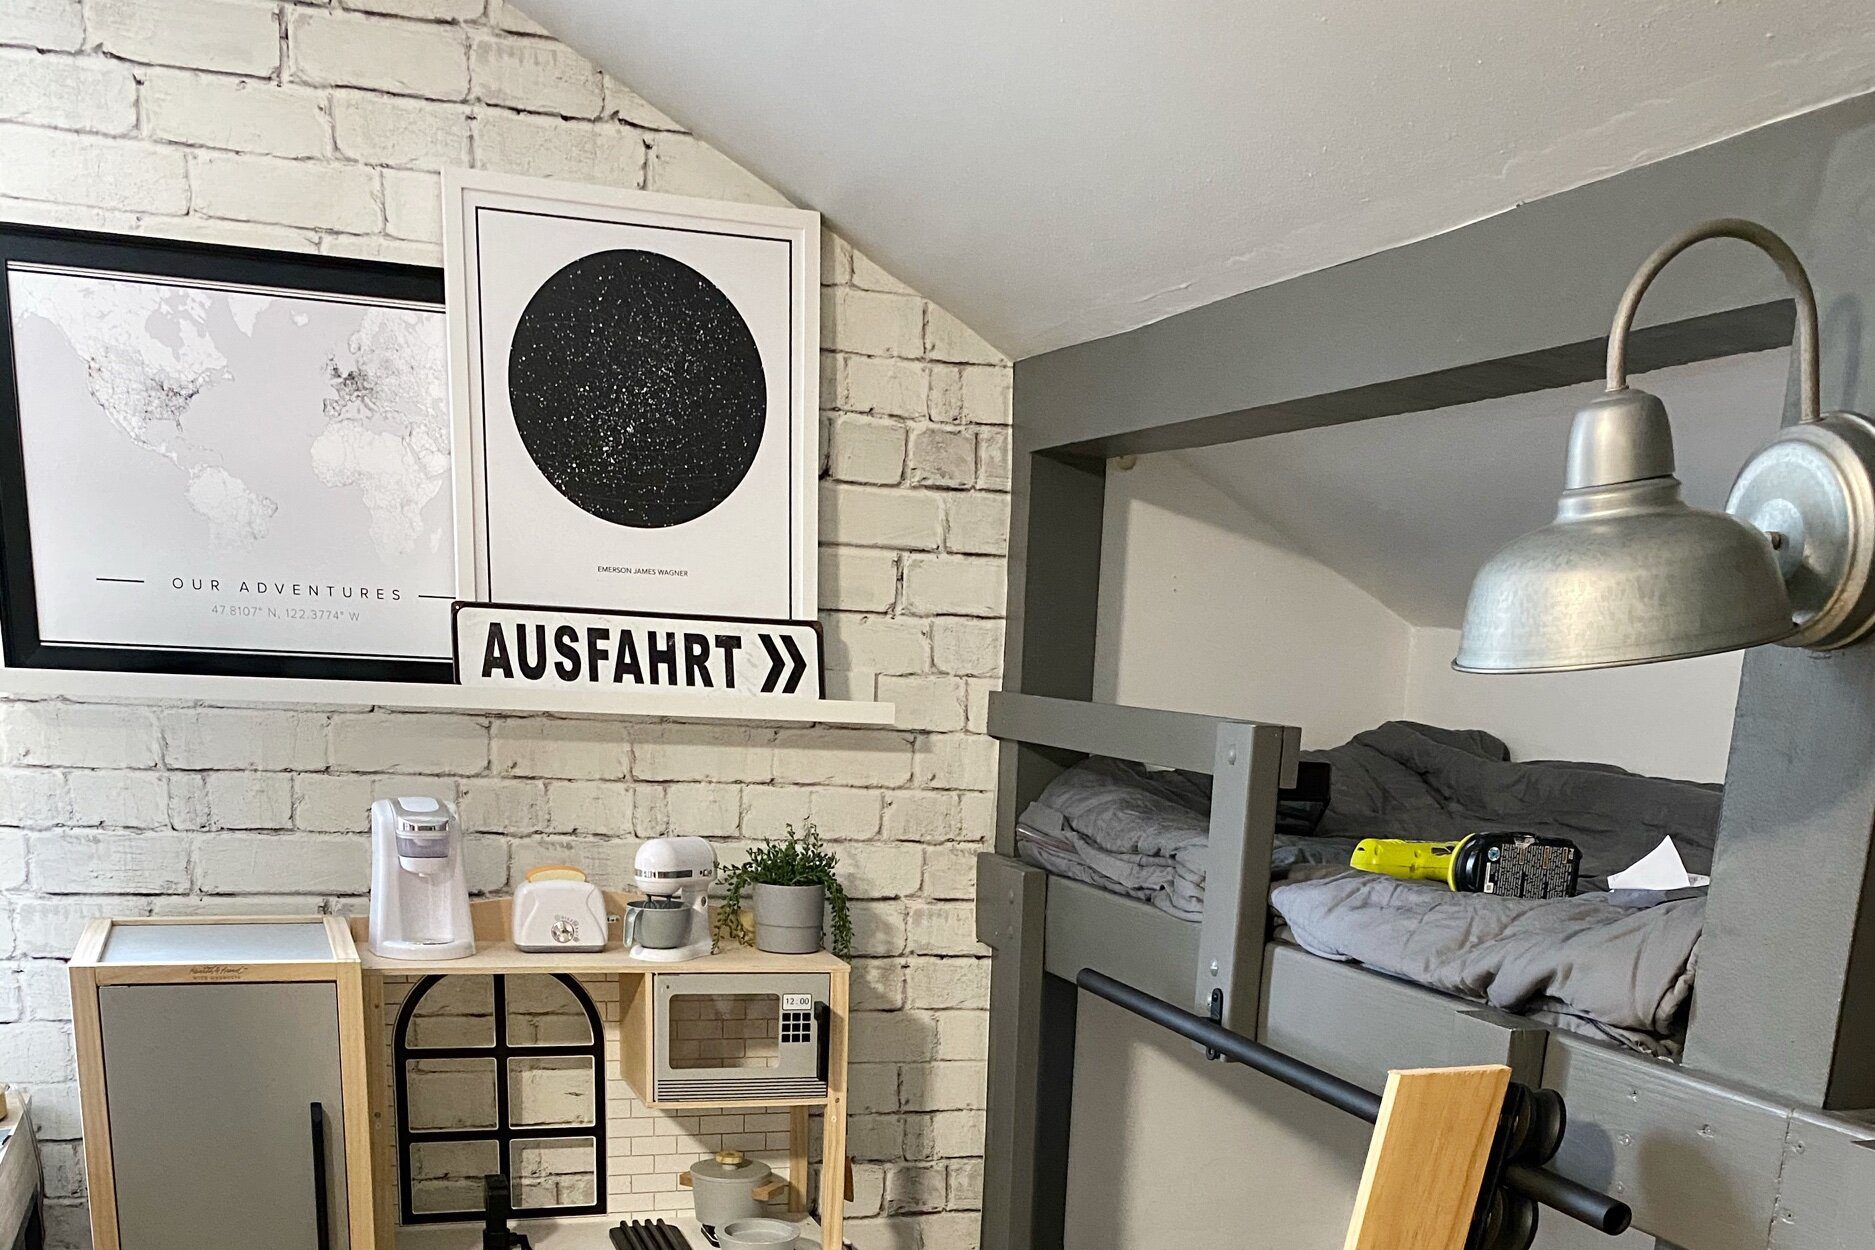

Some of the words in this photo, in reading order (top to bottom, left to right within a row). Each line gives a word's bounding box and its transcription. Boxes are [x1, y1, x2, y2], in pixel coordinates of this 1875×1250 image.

[598, 566, 631, 574] EMERSON
[658, 569, 688, 577] WAGNER
[172, 577, 220, 591] OUR
[239, 581, 401, 601] ADVENTURES
[348, 611, 360, 621] W
[481, 622, 742, 689] AUSFAHRT
